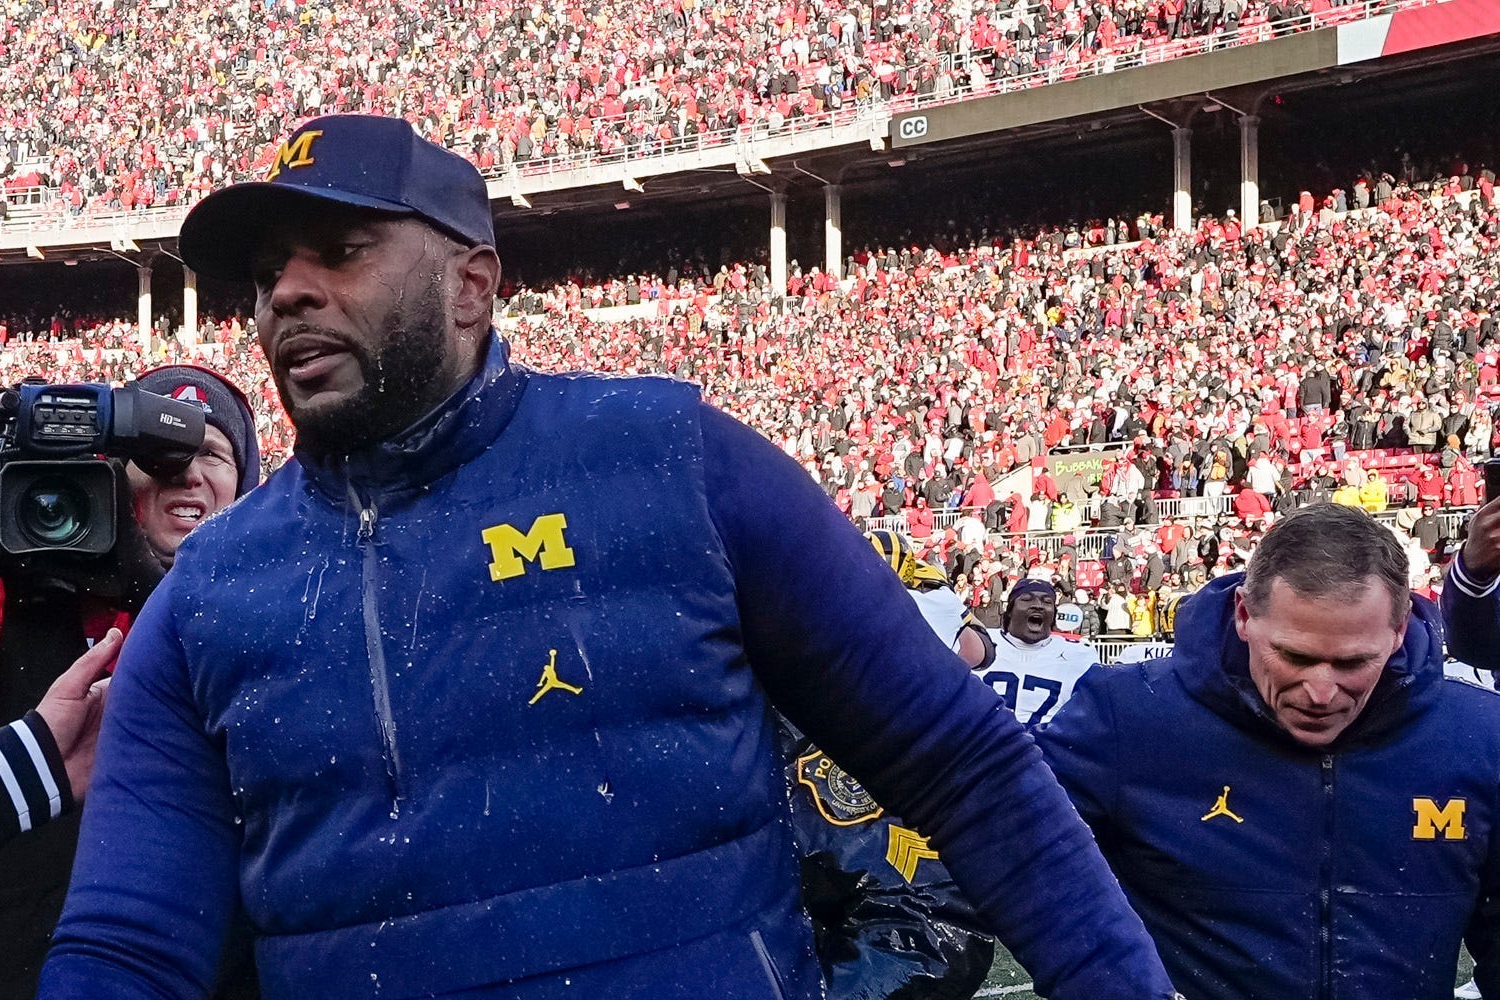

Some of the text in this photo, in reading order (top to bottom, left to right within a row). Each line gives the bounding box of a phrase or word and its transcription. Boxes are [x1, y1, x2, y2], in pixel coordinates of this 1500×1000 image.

[902, 119, 925, 136] CC
[266, 130, 324, 182] M
[160, 412, 173, 425] HD
[482, 513, 576, 582] M
[1144, 647, 1174, 659] KUZ
[983, 671, 1063, 725] 97
[814, 758, 831, 779] PO
[1412, 797, 1466, 840] M
